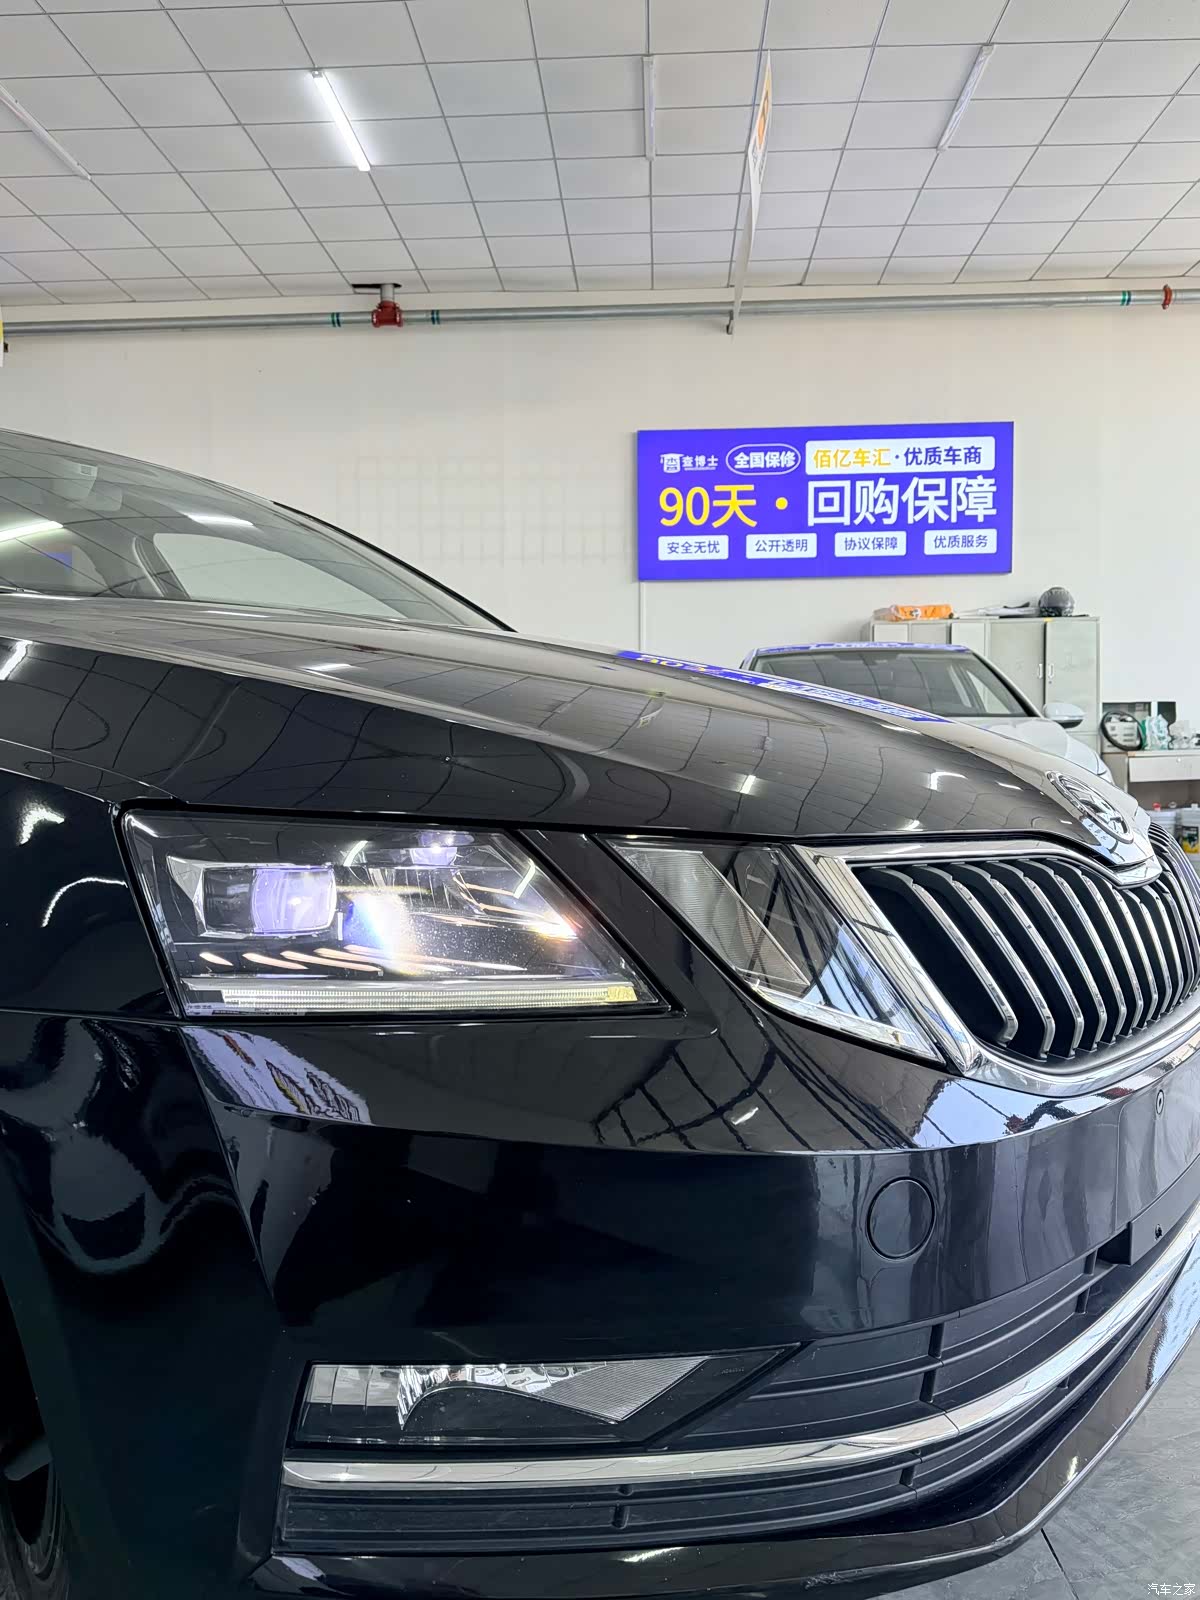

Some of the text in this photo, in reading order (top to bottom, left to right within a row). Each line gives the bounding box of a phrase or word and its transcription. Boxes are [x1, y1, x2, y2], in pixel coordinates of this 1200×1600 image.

[734, 451, 796, 468] 全国保修
[807, 475, 998, 527] 回购保障
[667, 541, 720, 554] 安全无忧
[755, 538, 809, 553] 公开透明
[844, 536, 899, 551] 协议保障
[933, 534, 988, 550] 优质服务
